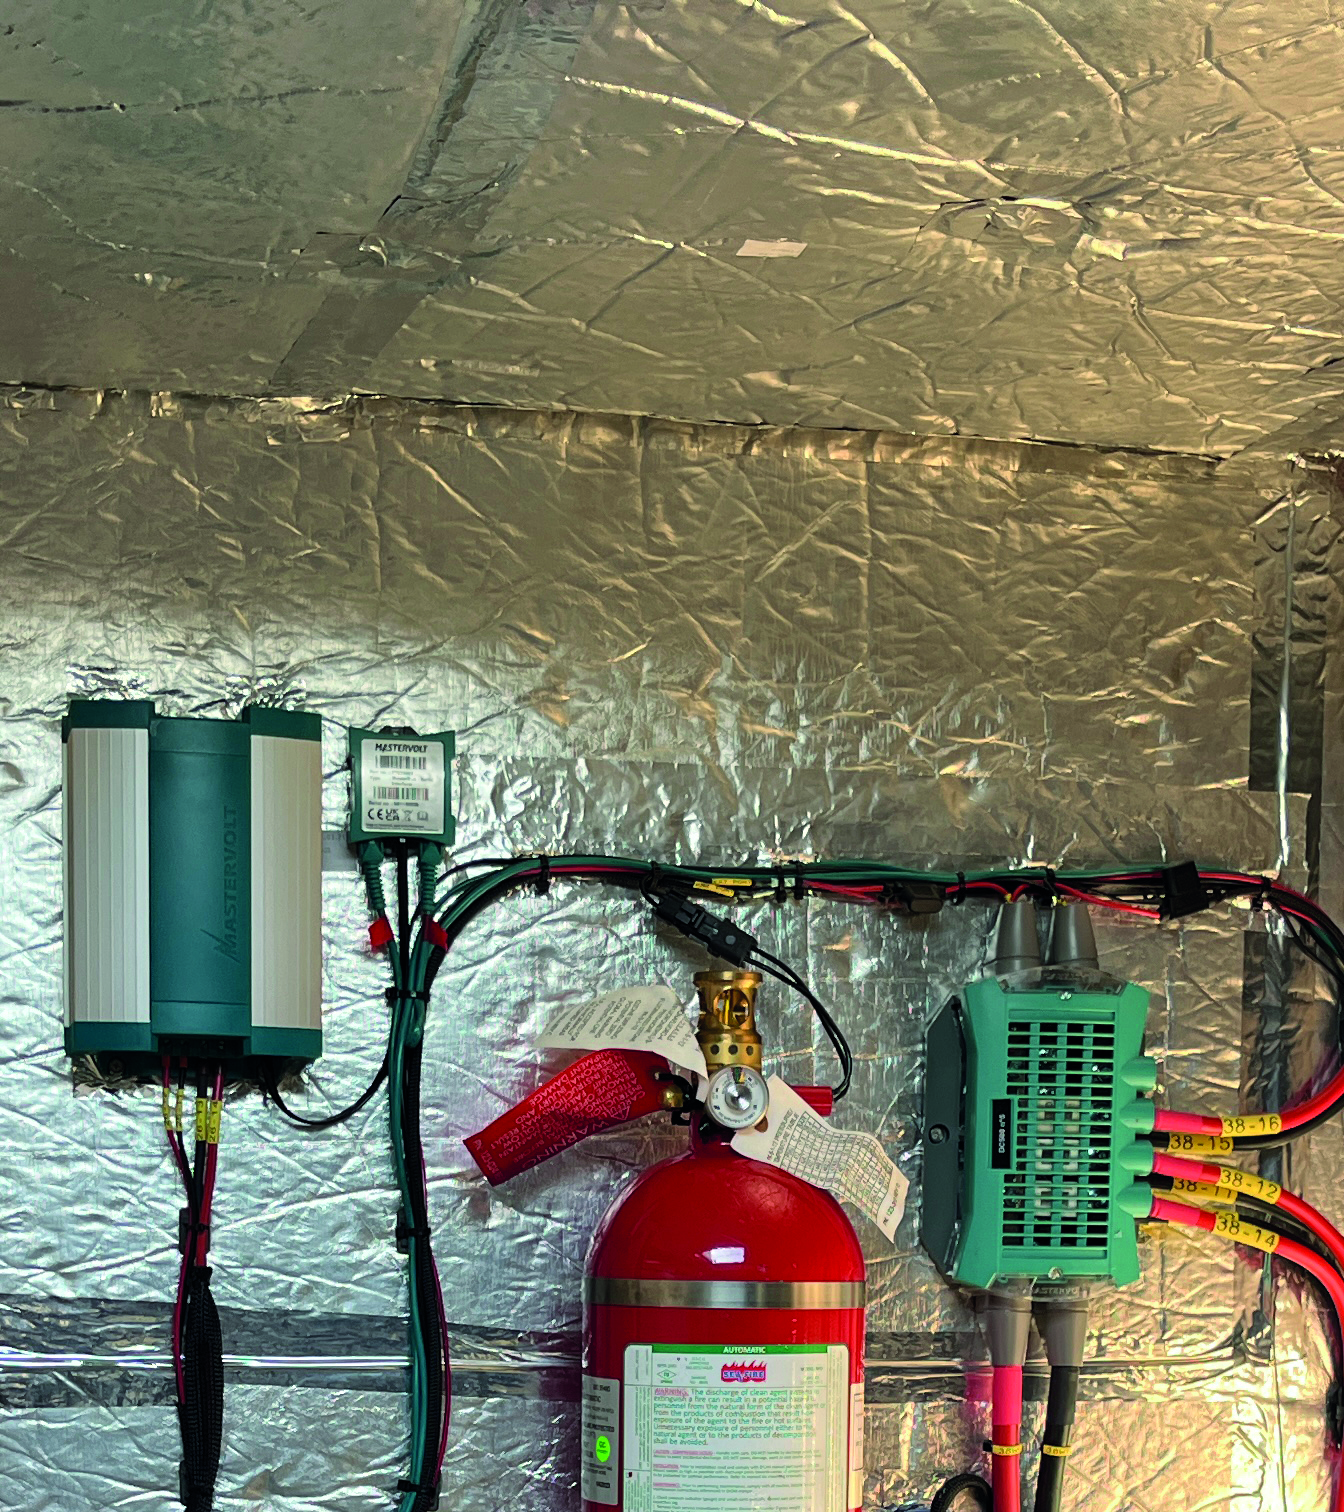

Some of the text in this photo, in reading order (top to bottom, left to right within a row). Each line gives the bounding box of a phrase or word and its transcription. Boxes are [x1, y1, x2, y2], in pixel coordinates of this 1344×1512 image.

[375, 743, 428, 753] MASTERVOLT
[201, 805, 241, 964] MASTERVOLT
[528, 1073, 571, 1108] DAMAGE
[513, 1107, 536, 1126] AND
[1223, 1117, 1279, 1134] 38-16
[521, 1118, 610, 1171] WARNING
[1170, 1134, 1231, 1150] 38-15
[1221, 1169, 1278, 1197] 38-12
[1216, 1216, 1276, 1247] 38-14
[723, 1346, 766, 1354] AUTOMATIC
